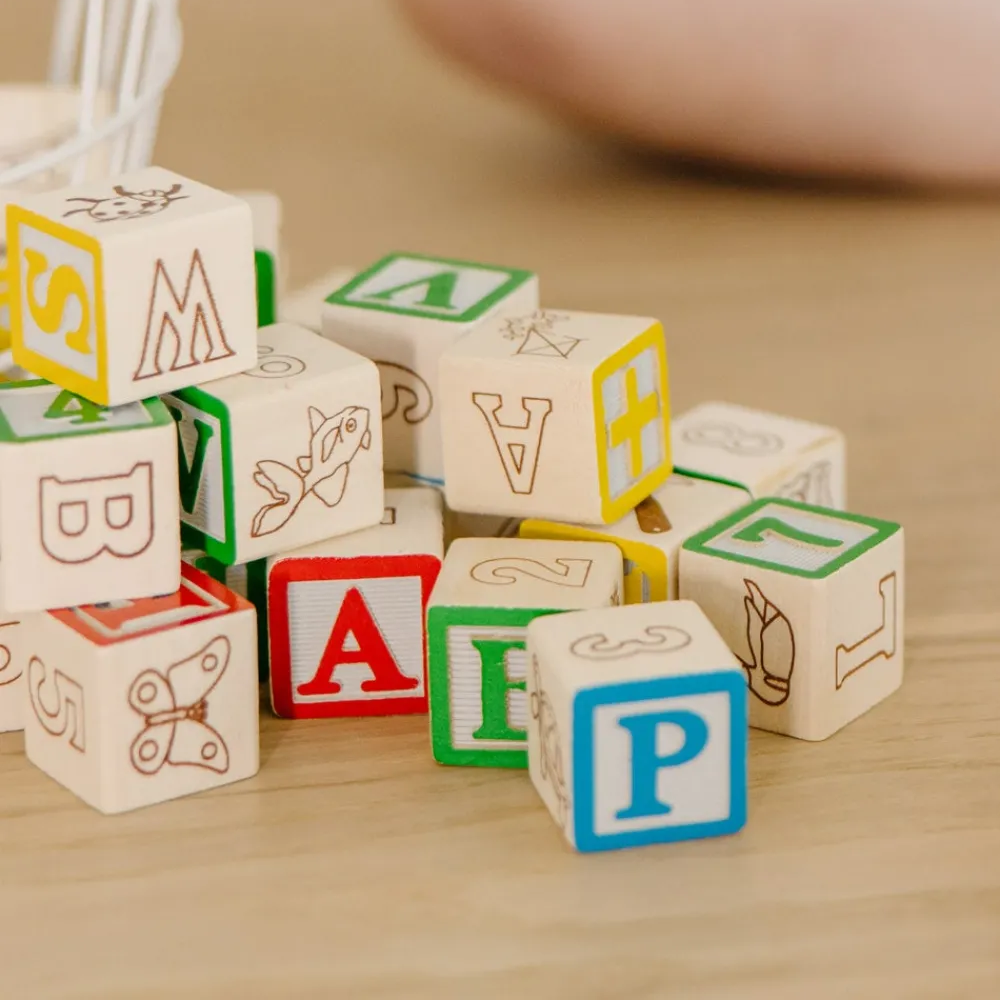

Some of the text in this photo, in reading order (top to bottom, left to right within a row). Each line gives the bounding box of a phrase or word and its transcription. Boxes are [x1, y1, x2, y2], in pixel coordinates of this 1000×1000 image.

[23, 247, 93, 355] S
[43, 389, 109, 425] 4
[471, 391, 553, 495] A
[39, 461, 155, 565] B
[731, 516, 844, 548] 7
[469, 557, 593, 588] 2
[296, 585, 420, 696] A
[570, 624, 692, 661] 3
[28, 655, 86, 754] 5
[614, 709, 710, 821] P
